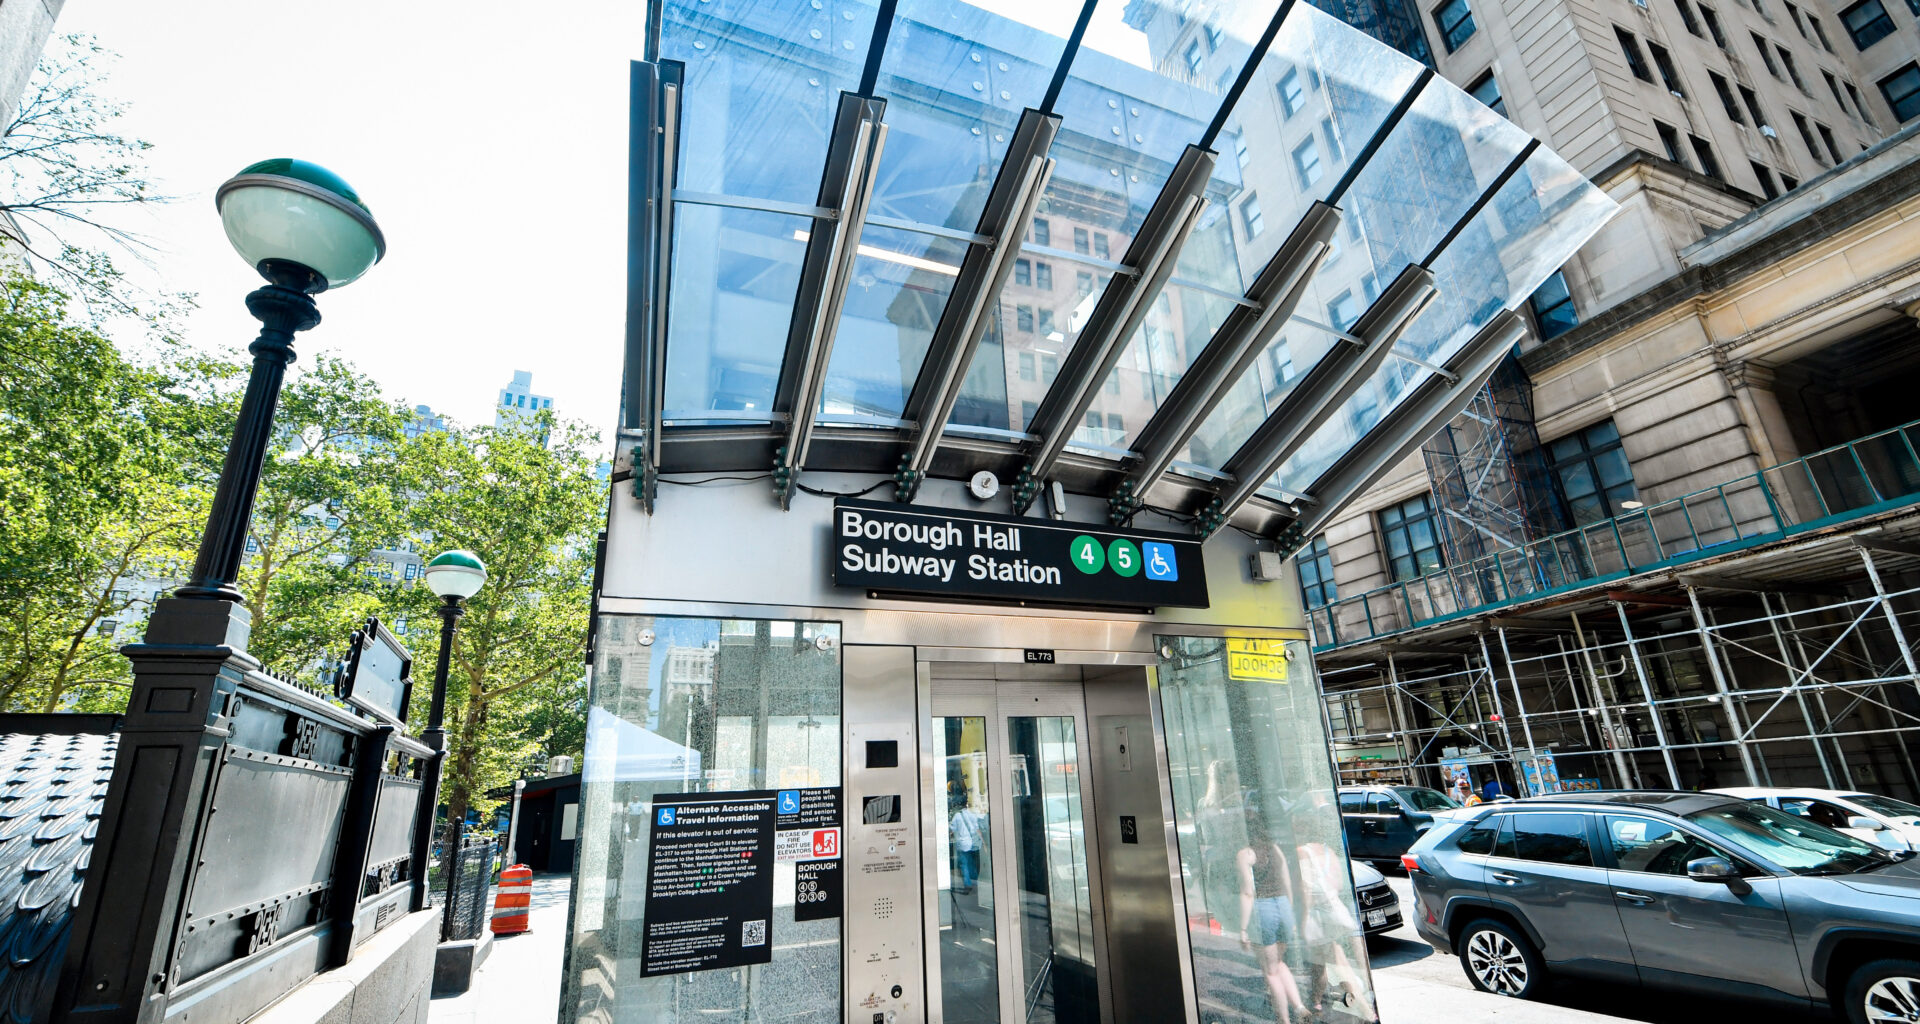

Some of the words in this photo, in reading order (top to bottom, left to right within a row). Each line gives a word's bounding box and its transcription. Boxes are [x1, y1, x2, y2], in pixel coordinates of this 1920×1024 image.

[842, 512, 963, 549] Borough
[973, 524, 1021, 552] Hall
[1081, 544, 1094, 564] 4
[1119, 548, 1131, 567] 5
[842, 545, 956, 582] Subway
[967, 555, 1061, 586] Station
[677, 806, 719, 814] Alternate
[722, 803, 770, 812] Accessible
[677, 816, 705, 825] Travel
[708, 814, 759, 823] Information
[799, 862, 836, 872] BOROUGH
[678, 888, 717, 896] College-bound
